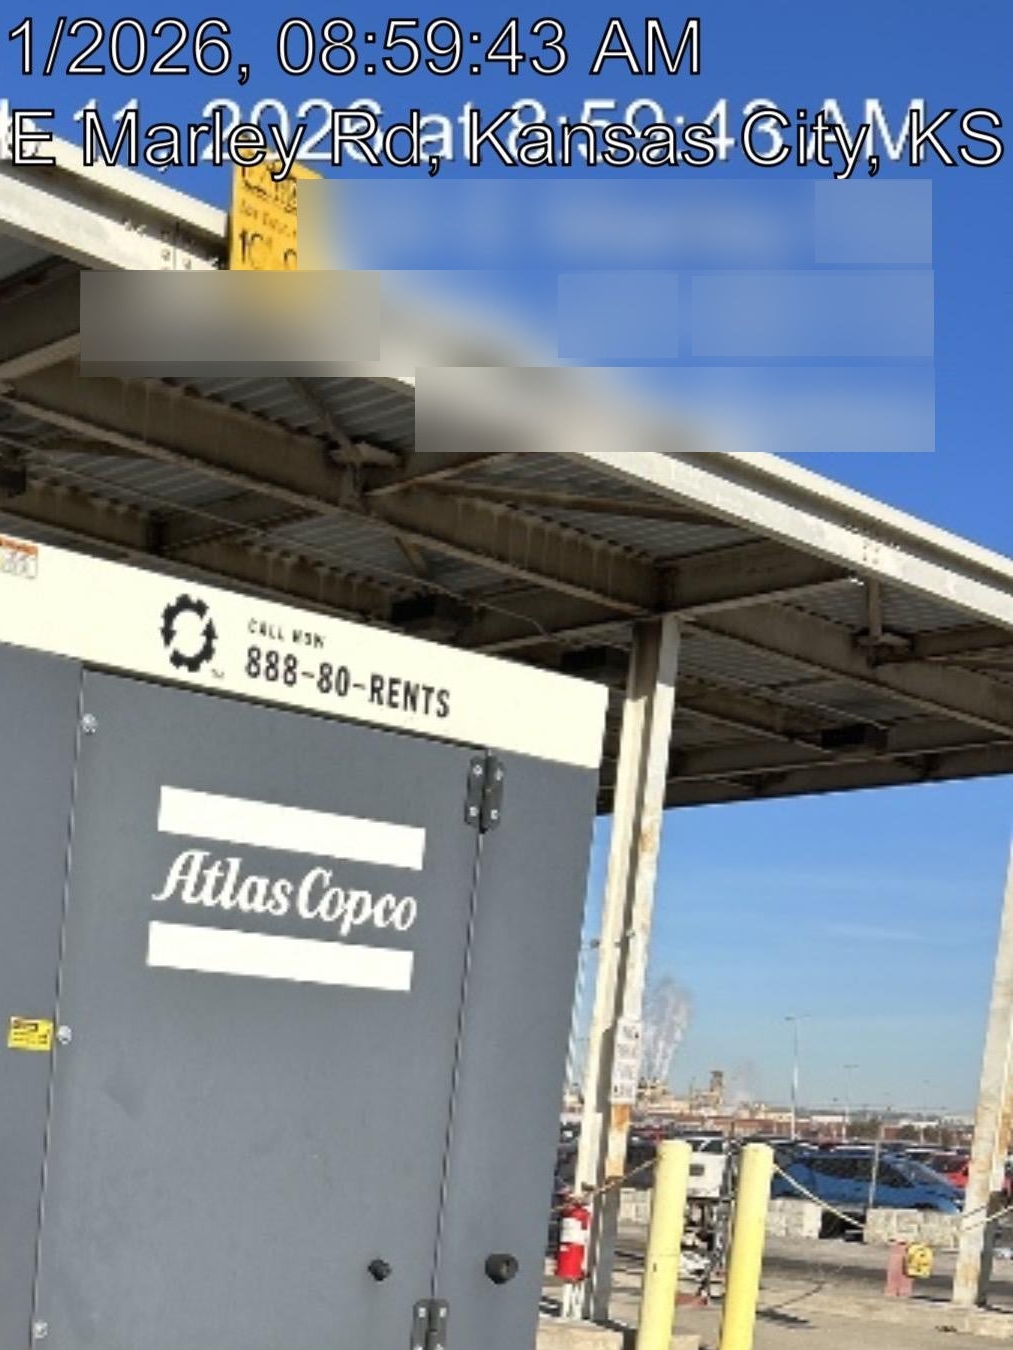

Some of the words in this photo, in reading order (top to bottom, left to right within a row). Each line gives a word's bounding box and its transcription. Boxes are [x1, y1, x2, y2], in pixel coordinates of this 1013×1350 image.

[244, 645, 452, 718] 888-80-RENTS
[151, 849, 293, 916] Atlas
[295, 866, 417, 936] Copco
